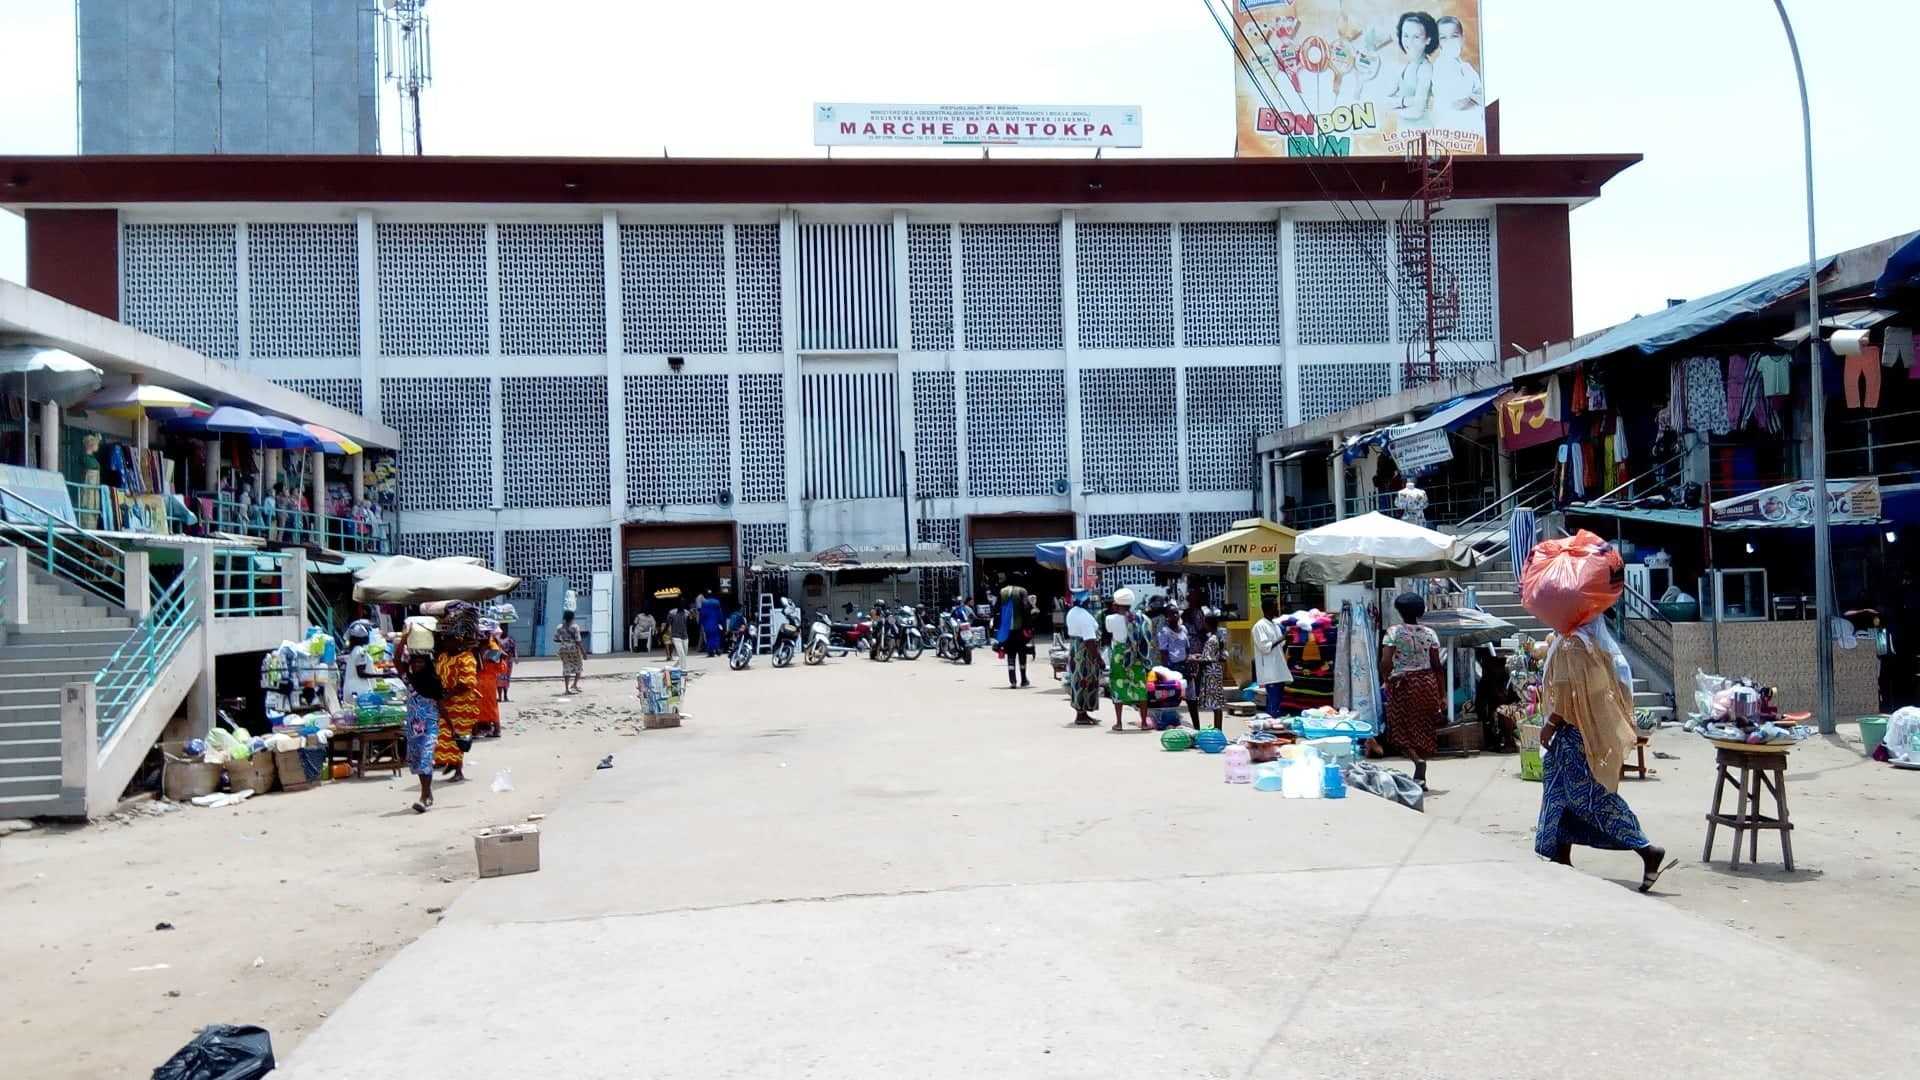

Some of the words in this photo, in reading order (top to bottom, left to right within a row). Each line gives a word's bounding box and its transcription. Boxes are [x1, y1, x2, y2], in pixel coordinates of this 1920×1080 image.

[840, 122, 954, 135] MARCHE
[966, 123, 1113, 136] DANTOKPA
[1383, 133, 1397, 141] Le
[1222, 544, 1247, 554] MTN
[1250, 543, 1277, 553] Poxi
